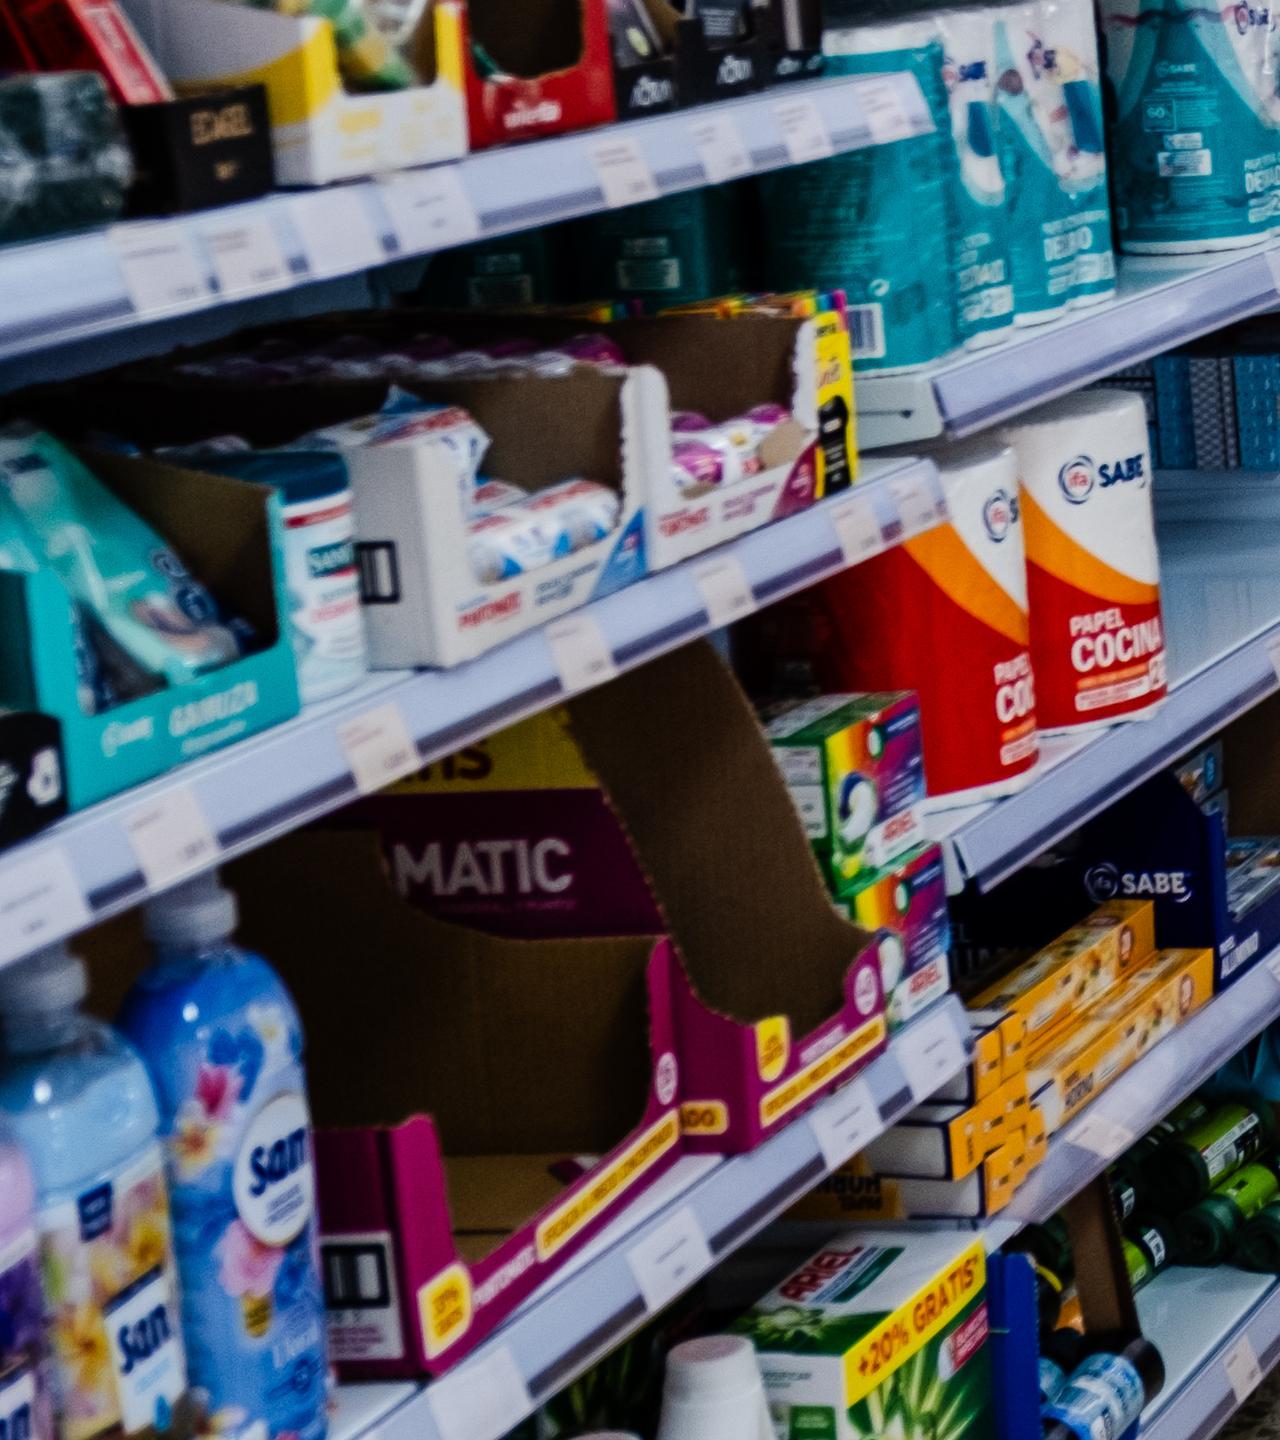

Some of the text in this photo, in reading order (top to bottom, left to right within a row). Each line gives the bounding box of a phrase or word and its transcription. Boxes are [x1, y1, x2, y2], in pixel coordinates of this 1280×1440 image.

[1098, 453, 1146, 490] SABE
[1069, 607, 1124, 639] PAPEL
[1071, 618, 1163, 673] COCINA
[391, 837, 575, 897] MATIC
[1121, 872, 1187, 895] SABE
[856, 1320, 910, 1380] +20%
